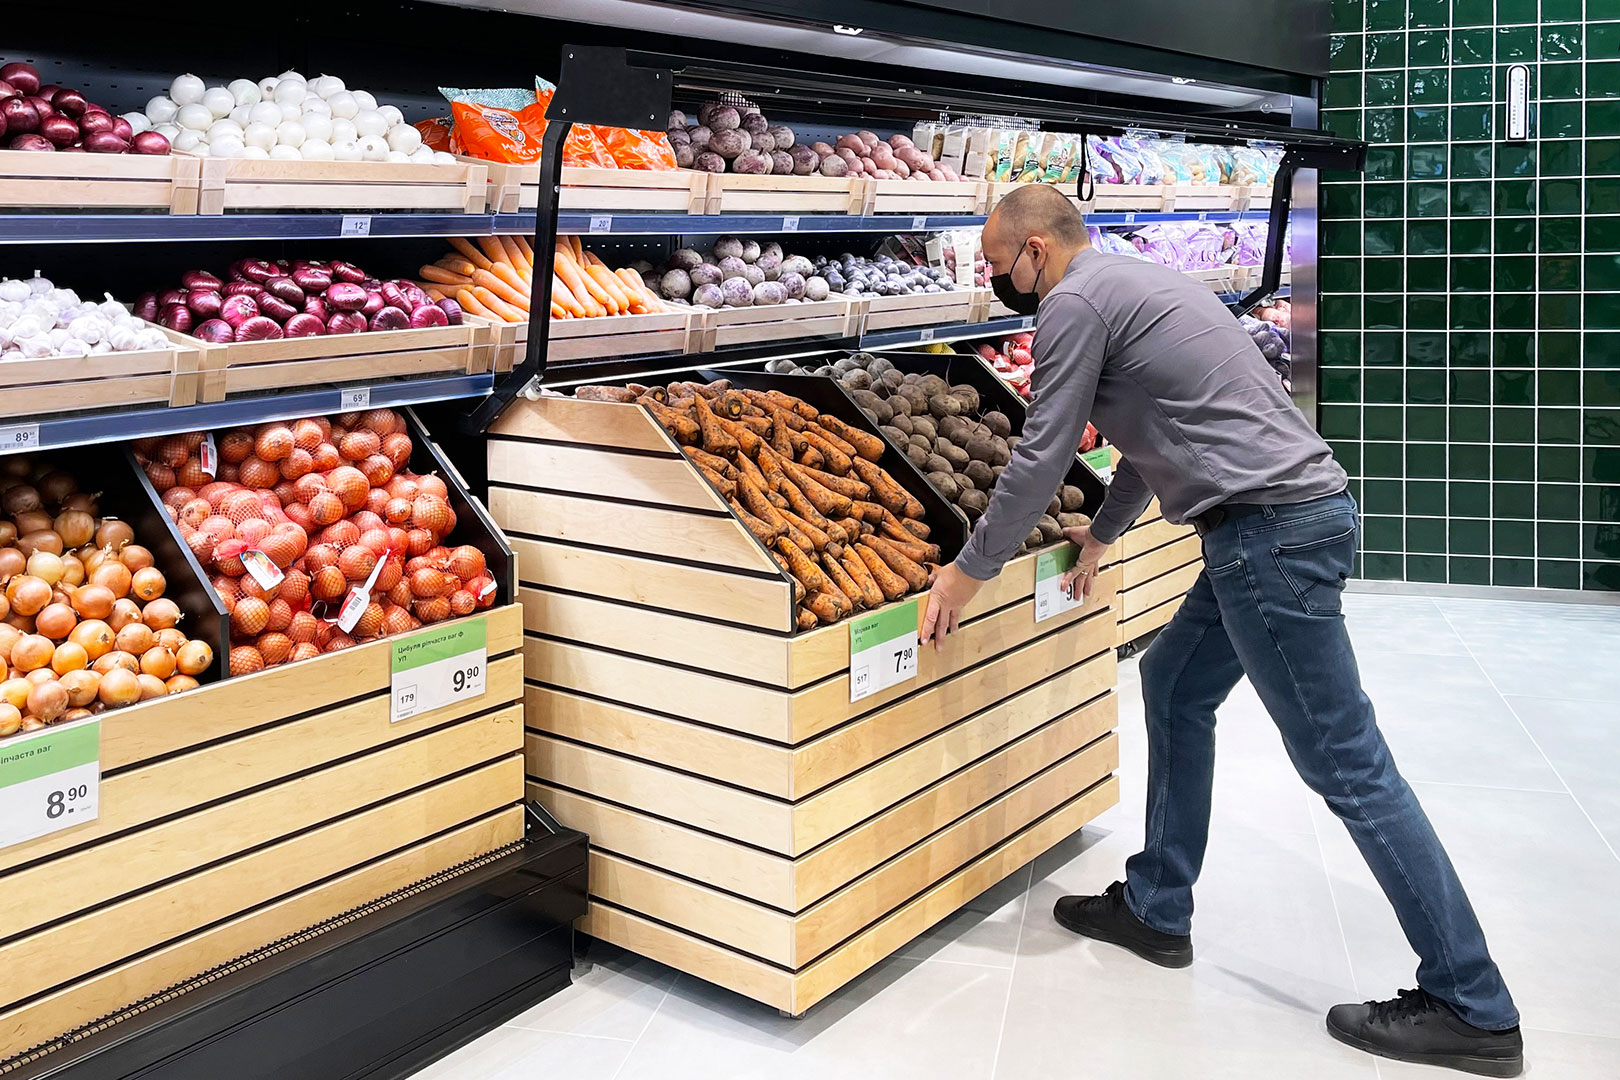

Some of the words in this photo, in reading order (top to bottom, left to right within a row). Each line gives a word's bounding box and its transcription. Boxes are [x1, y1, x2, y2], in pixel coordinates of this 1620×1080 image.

[397, 643, 421, 654] Цибуля
[421, 636, 447, 648] ріпчаста
[447, 632, 457, 640] ваг
[397, 655, 407, 663] УП
[857, 673, 867, 685] 517
[400, 693, 415, 704] 179
[0, 749, 35, 764] іпчаста
[37, 745, 52, 754] ваг
